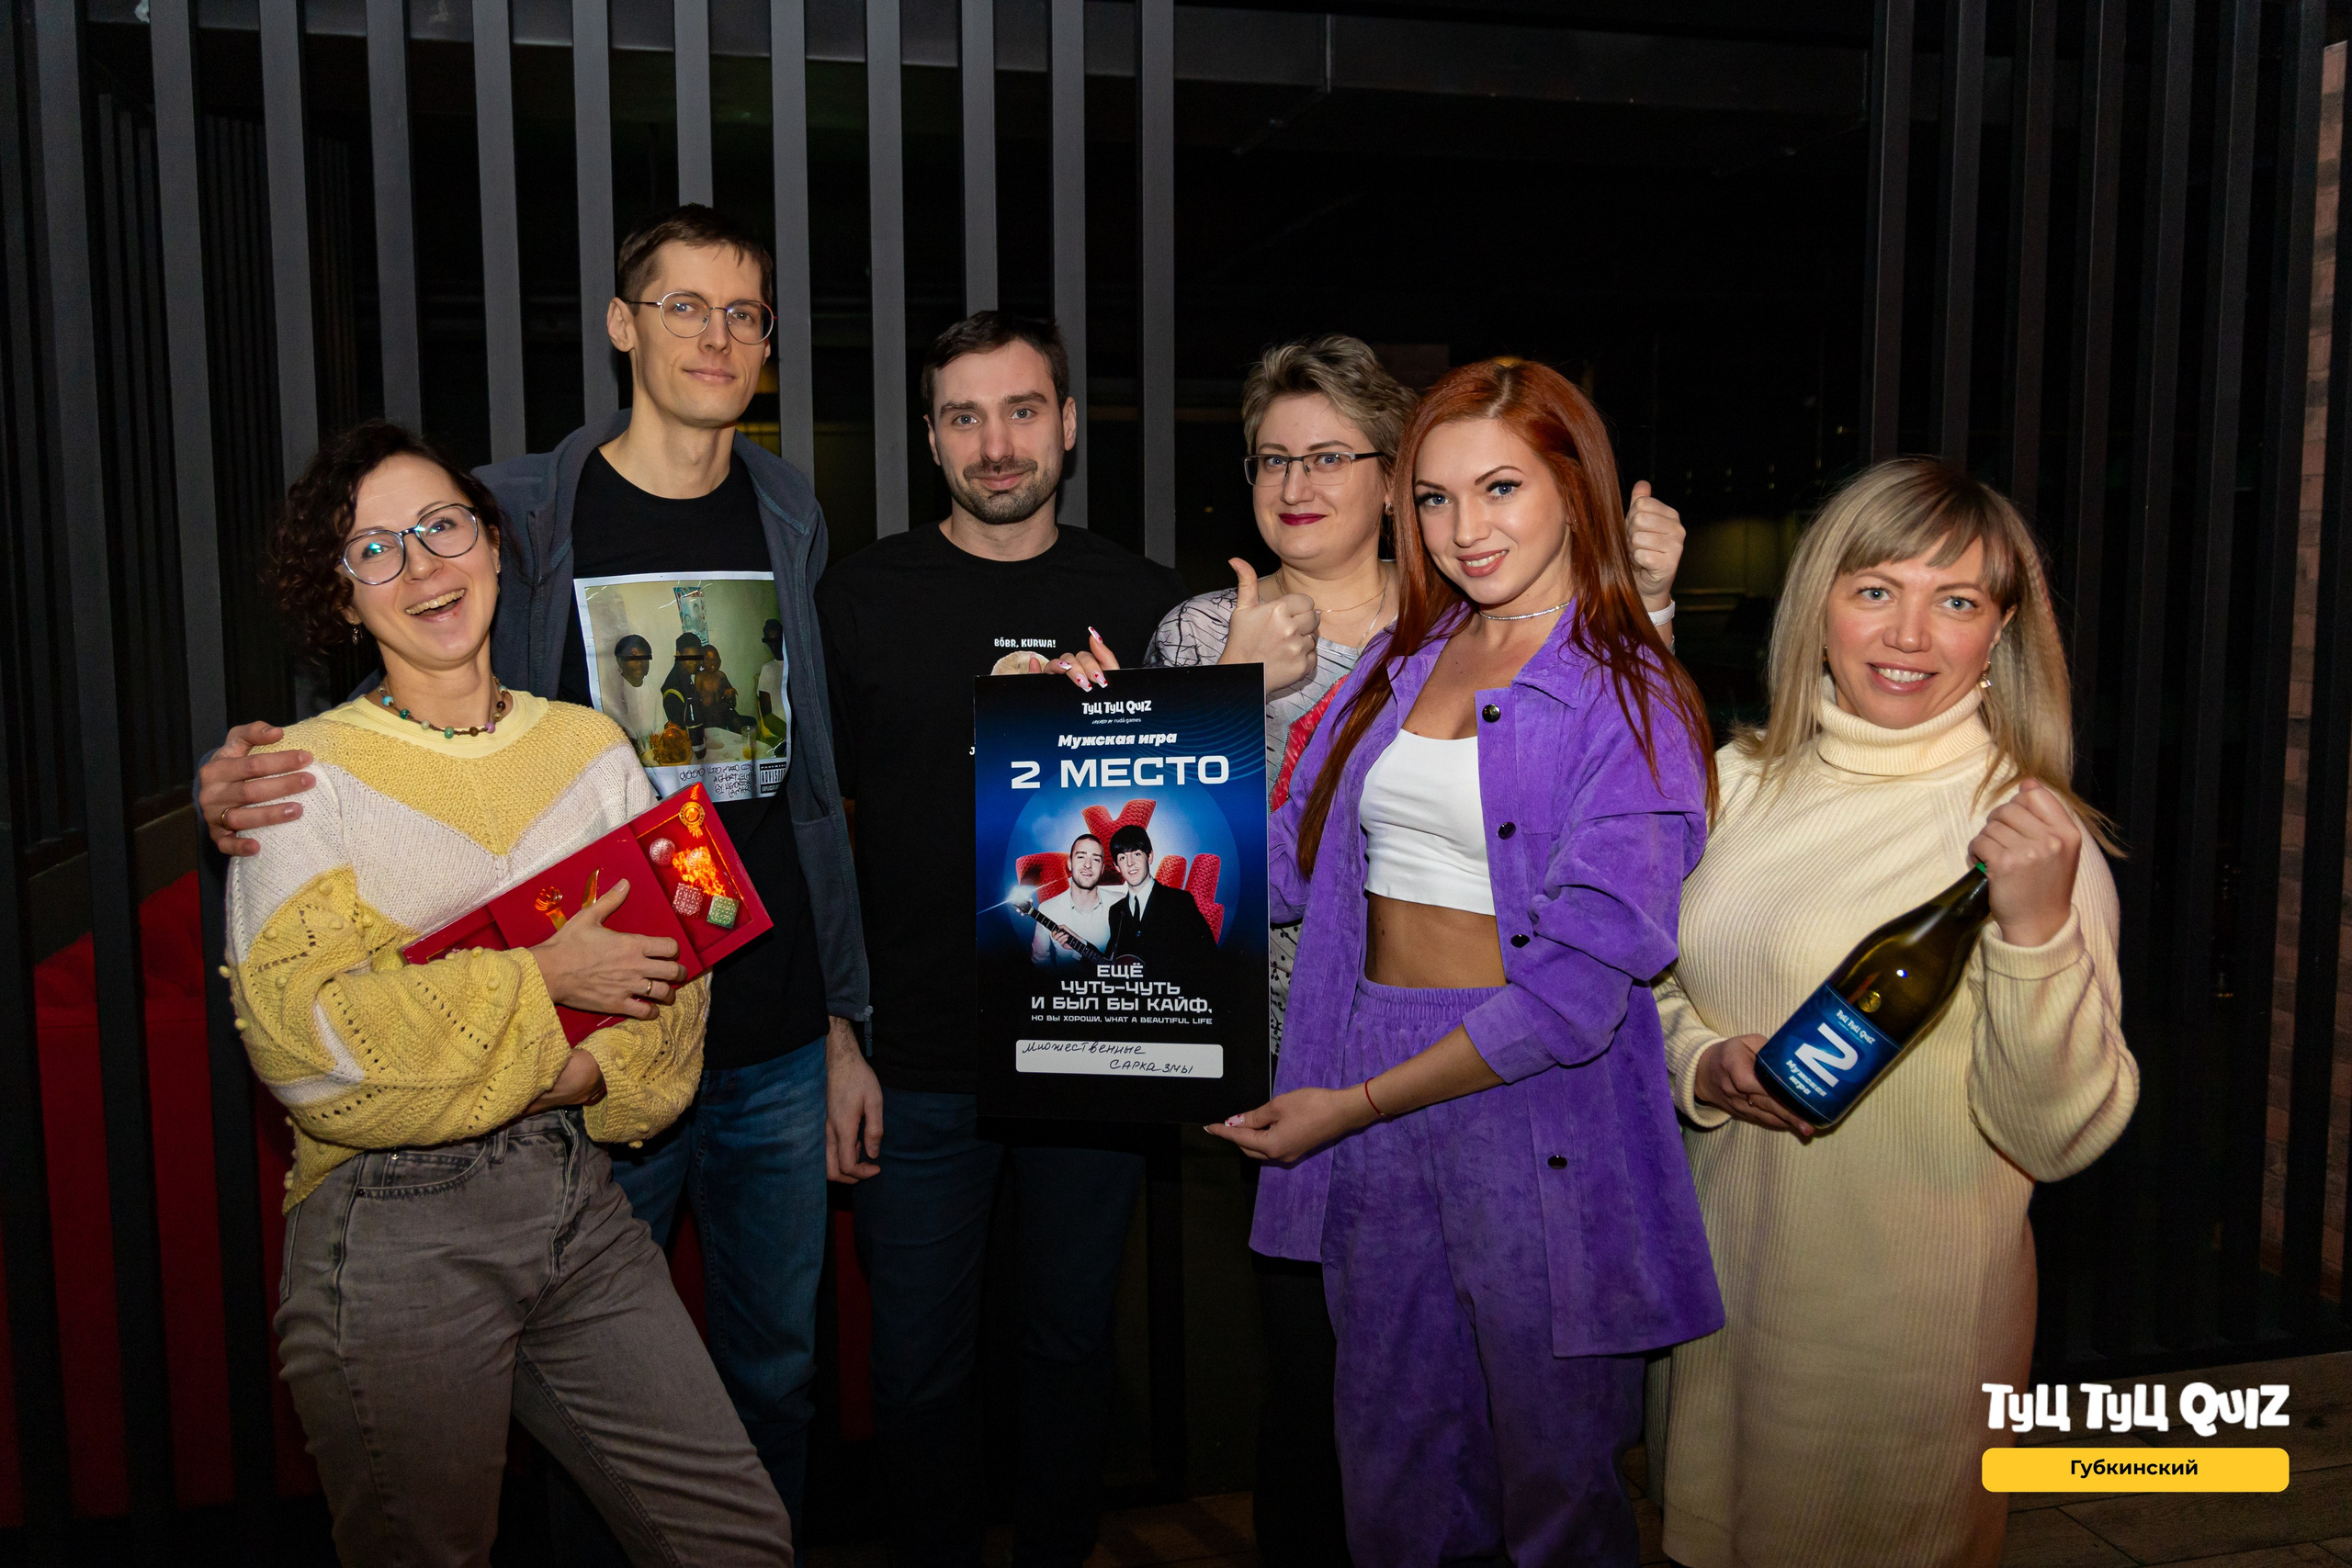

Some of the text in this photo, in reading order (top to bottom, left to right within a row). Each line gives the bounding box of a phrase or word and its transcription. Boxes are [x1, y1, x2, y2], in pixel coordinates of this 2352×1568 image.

[994, 637, 1057, 648] BÓBR, KURWA!
[1058, 732, 1177, 749] Мужская игра
[1011, 755, 1229, 789] 2 МЕСТО
[1097, 962, 1144, 978] ЕЩЁ
[1060, 980, 1181, 996] ЧУТЬ-ЧУТЬ
[1031, 996, 1213, 1014] И БЫЛ БЫ КАЙФ,
[1794, 1022, 1859, 1088] 2
[1785, 1059, 1827, 1097] Мужская
[1789, 1075, 1812, 1096] игра
